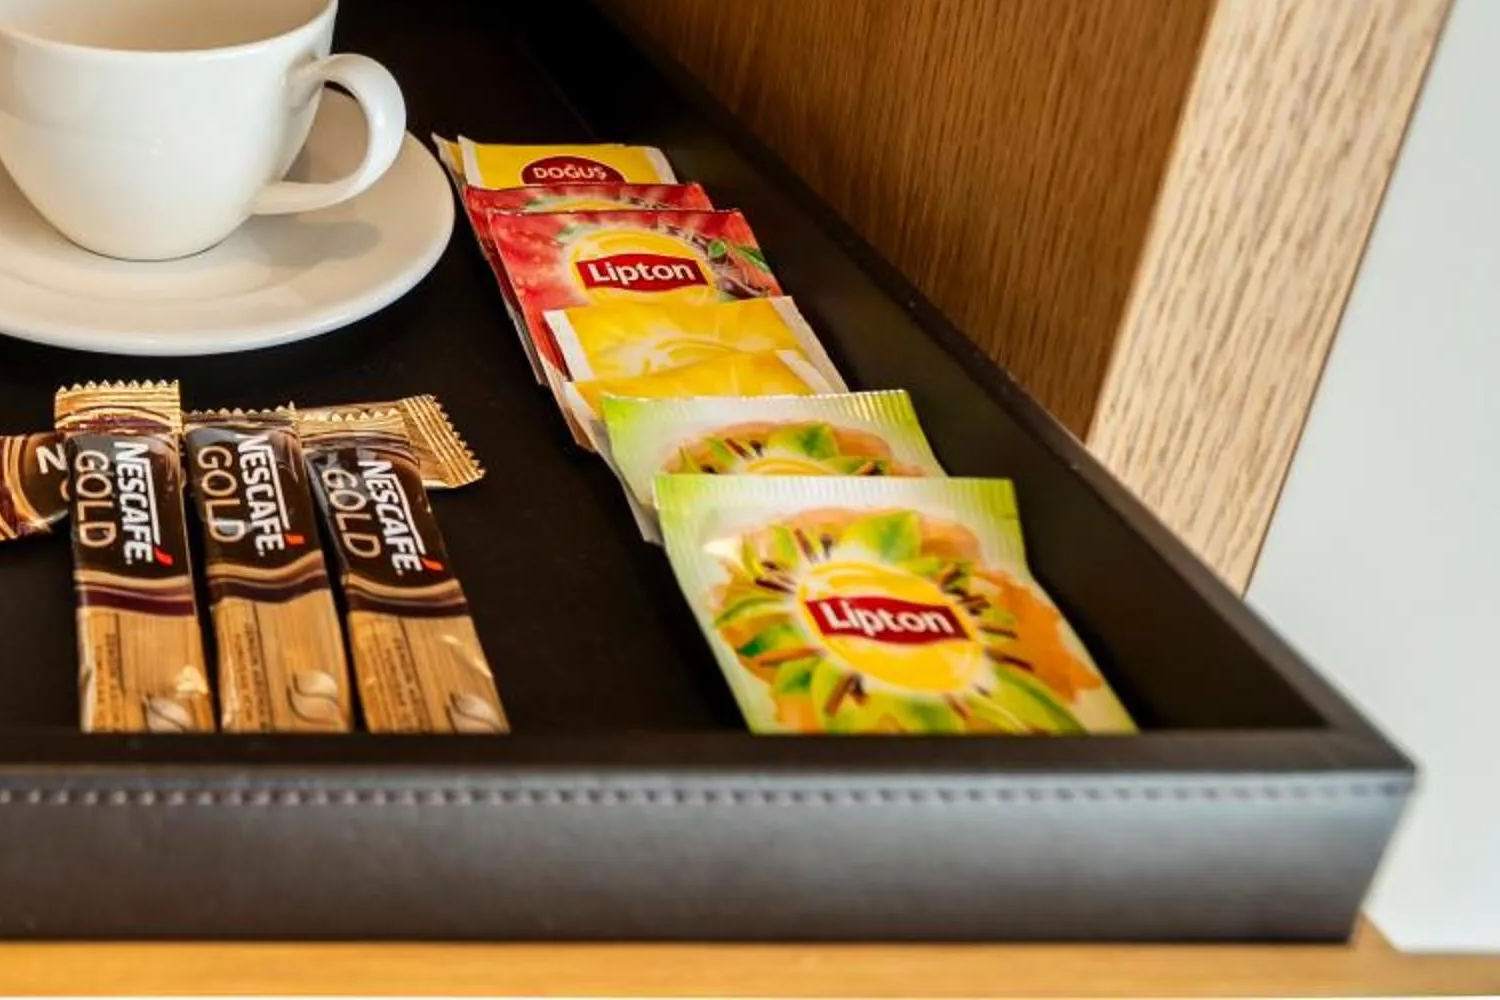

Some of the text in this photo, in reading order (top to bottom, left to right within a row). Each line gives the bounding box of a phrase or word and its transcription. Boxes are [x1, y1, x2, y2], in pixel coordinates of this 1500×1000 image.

[587, 262, 696, 285] Lipton
[75, 449, 117, 548] GOLD
[197, 445, 245, 542] GOLD
[321, 469, 381, 558] GOLD
[819, 600, 954, 636] Lipton
